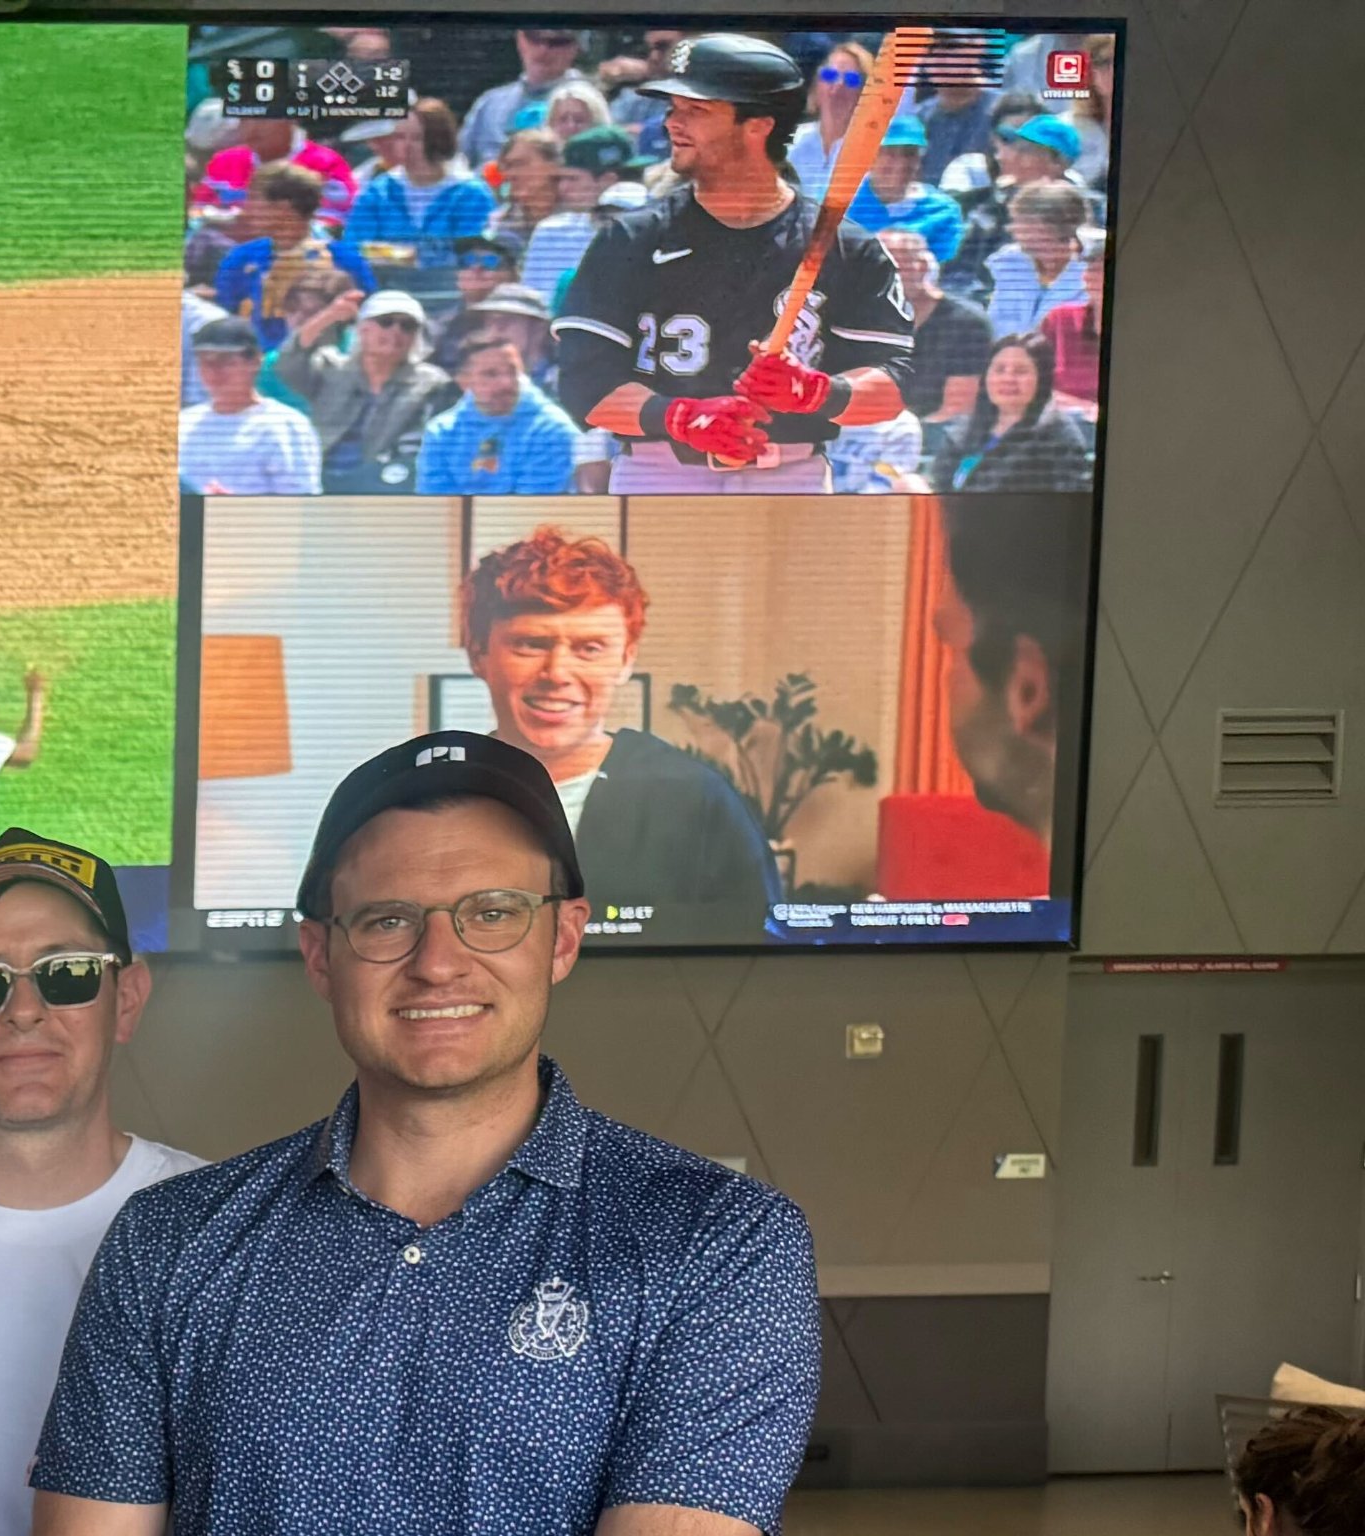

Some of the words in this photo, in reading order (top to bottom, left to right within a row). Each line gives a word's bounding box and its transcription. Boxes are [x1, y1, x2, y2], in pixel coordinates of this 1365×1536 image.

[255, 60, 275, 79] 0
[374, 66, 403, 81] 1-2
[255, 83, 275, 102] 0
[633, 312, 711, 377] 23
